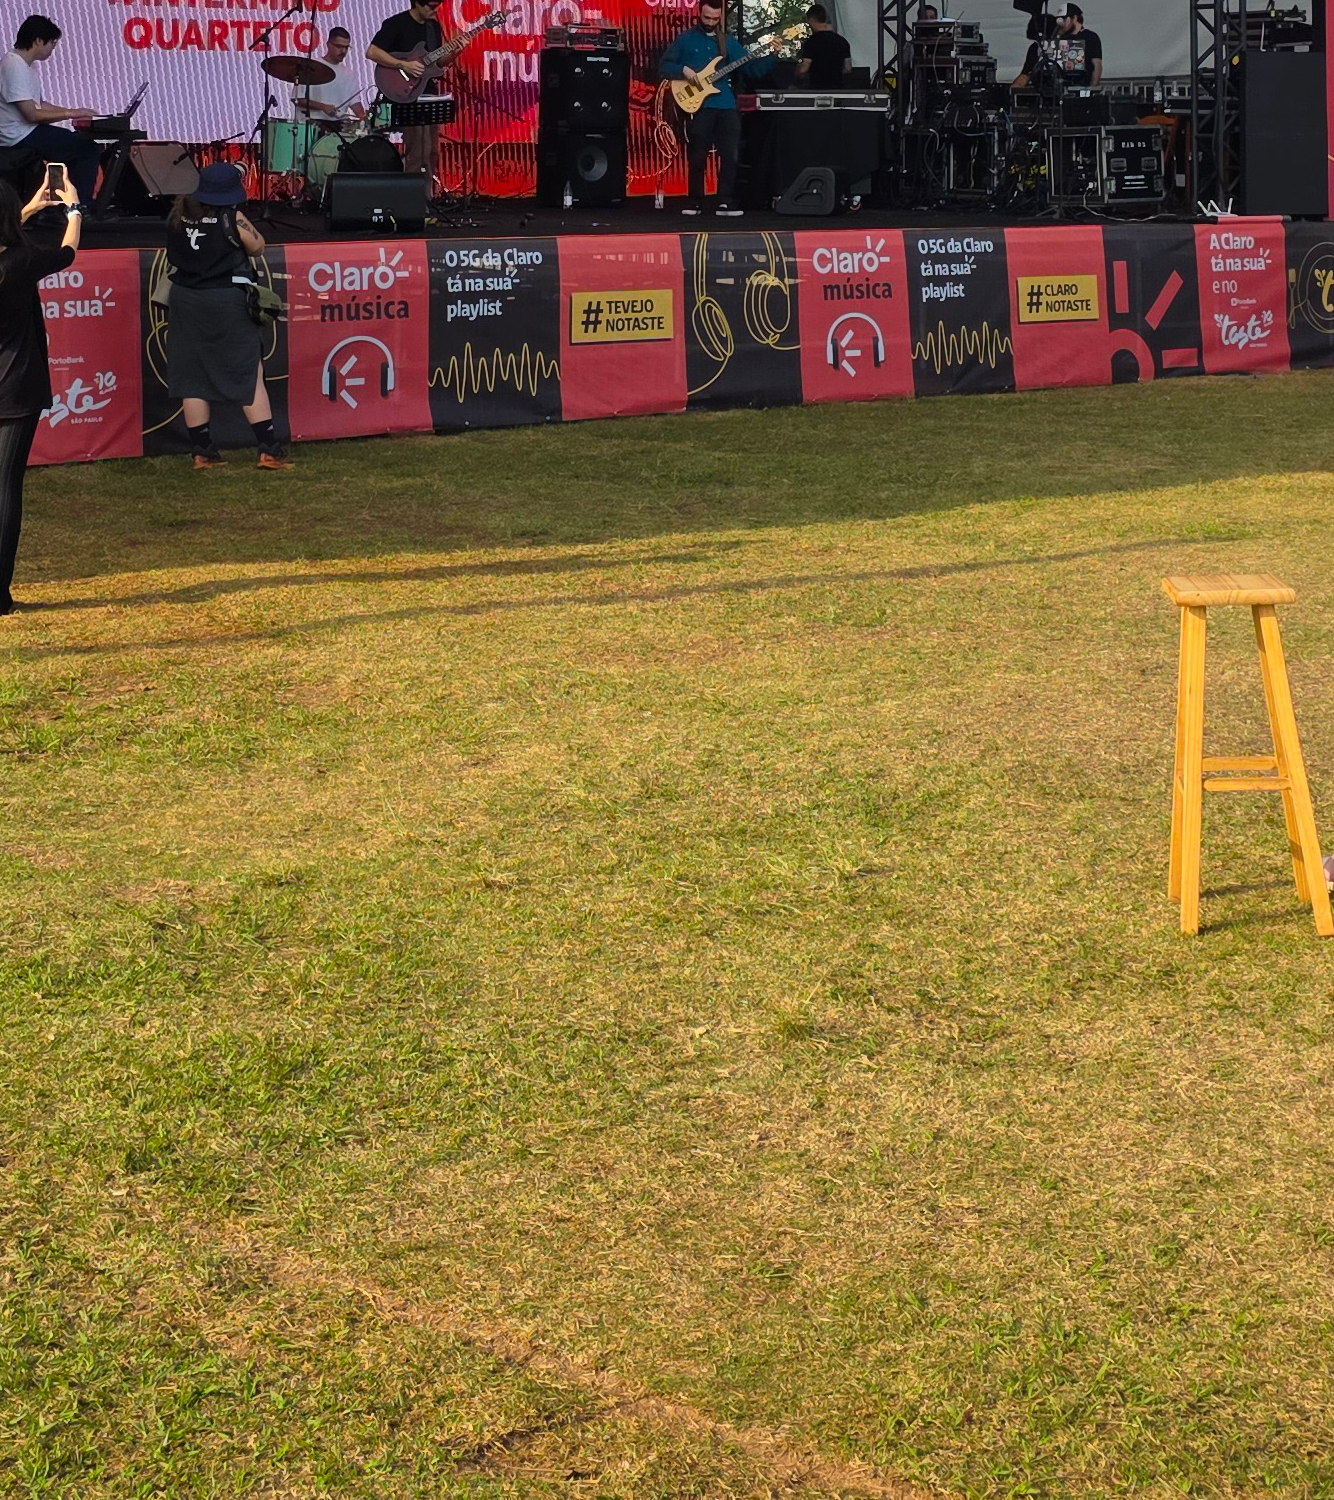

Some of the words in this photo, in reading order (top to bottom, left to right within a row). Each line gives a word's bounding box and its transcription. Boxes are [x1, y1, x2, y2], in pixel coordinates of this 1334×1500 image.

[123, 17, 321, 54] QUARTETO
[918, 239, 927, 255] O
[929, 239, 945, 254] 5G
[947, 238, 962, 253] da
[963, 237, 994, 253] Claro
[1209, 234, 1220, 250] A
[1221, 233, 1255, 250] Claro
[445, 251, 458, 267] O
[460, 250, 479, 267] 5G
[482, 249, 501, 266] da
[503, 248, 543, 265] Claro
[812, 247, 879, 274] Claro
[1211, 255, 1224, 272] tá
[1226, 258, 1241, 271] na
[1243, 256, 1266, 271] sua
[308, 261, 394, 292] Claro
[920, 260, 933, 277] tá
[934, 262, 949, 276] na
[951, 262, 971, 276] sua
[38, 271, 84, 289] aro
[447, 276, 461, 292] tá
[464, 277, 483, 292] na
[486, 276, 513, 291] sua
[1212, 280, 1220, 294] e
[1221, 279, 1238, 294] no
[823, 278, 893, 301] música
[921, 282, 965, 303] playlist
[63, 299, 103, 318] sua
[320, 295, 410, 323] música
[447, 299, 503, 322] playlist
[1045, 299, 1092, 313] NOTASTE
[605, 316, 665, 332] NOTASTE
